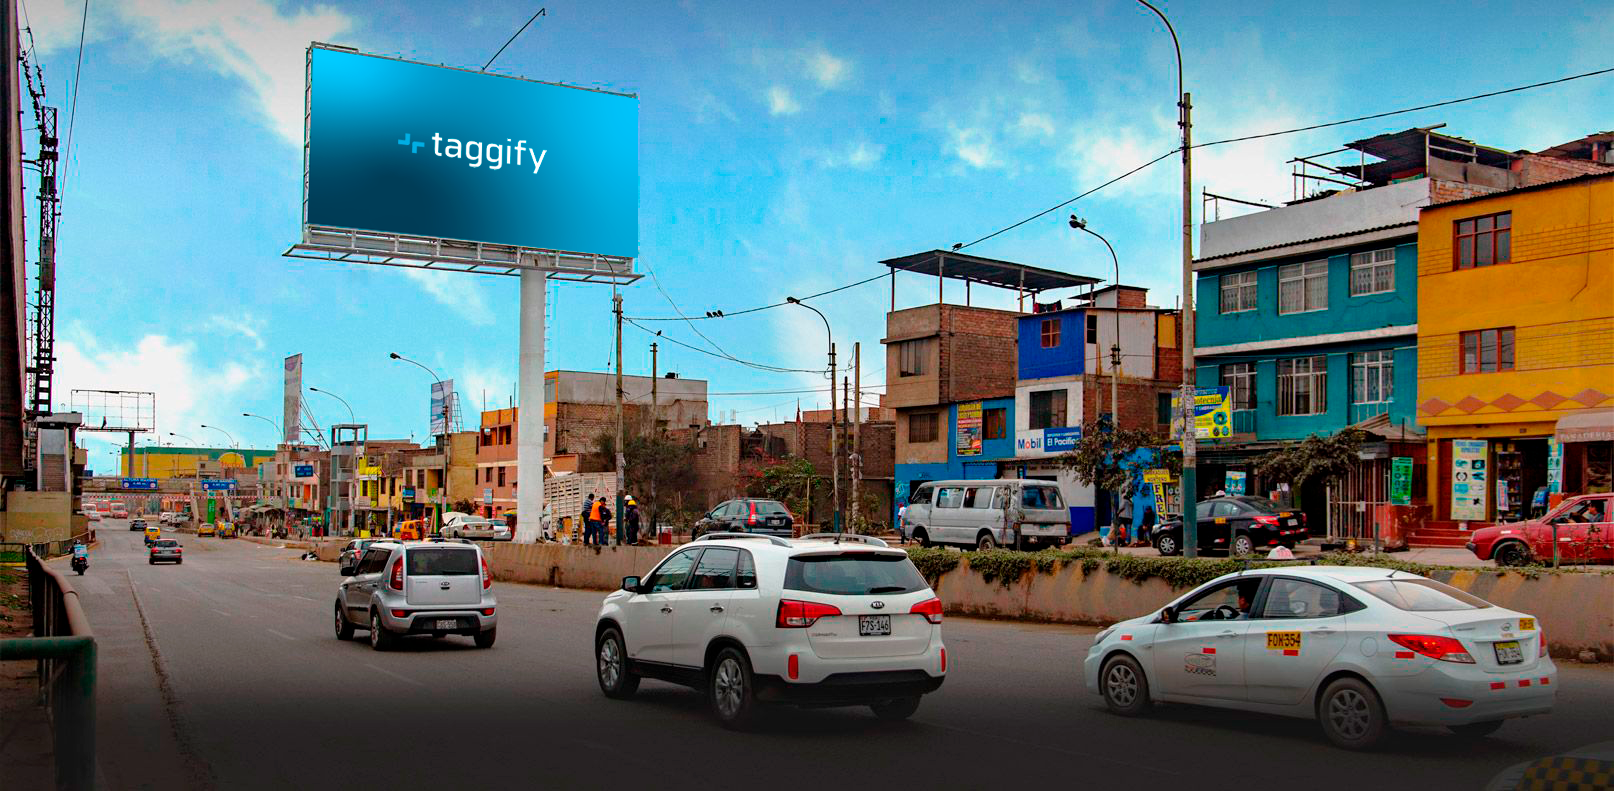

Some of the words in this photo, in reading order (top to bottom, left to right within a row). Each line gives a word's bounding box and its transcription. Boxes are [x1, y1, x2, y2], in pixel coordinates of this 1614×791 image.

[431, 132, 548, 174] taggify
[1018, 438, 1041, 449] Mobil
[1047, 438, 1053, 446] El
[861, 620, 889, 631] F7S-146
